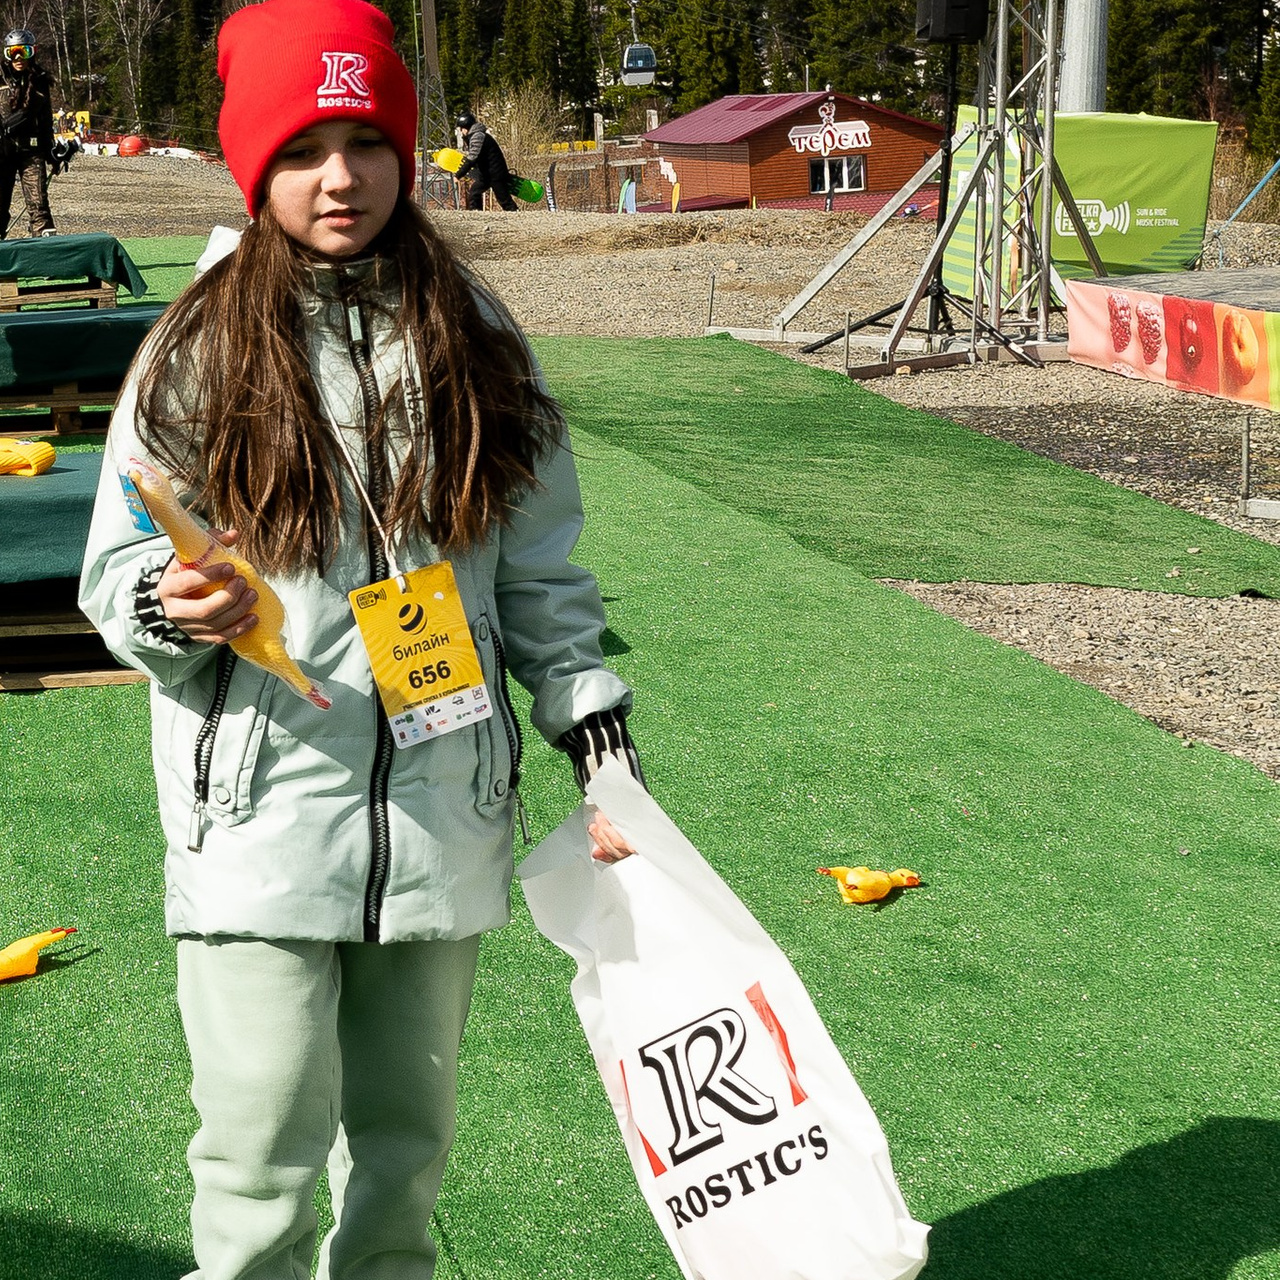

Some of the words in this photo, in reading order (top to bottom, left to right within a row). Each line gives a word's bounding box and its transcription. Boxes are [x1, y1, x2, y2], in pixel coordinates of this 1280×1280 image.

[317, 97, 372, 109] ROSTIC'S
[1136, 208, 1149, 217] SUN
[1154, 208, 1168, 216] RIDE
[1136, 219, 1154, 227] MUSIC
[1154, 219, 1180, 227] FESTIVAL
[392, 633, 450, 662] билайн
[408, 660, 452, 690] 656
[638, 1007, 779, 1167] R
[665, 1125, 828, 1230] ROSTIC'S
